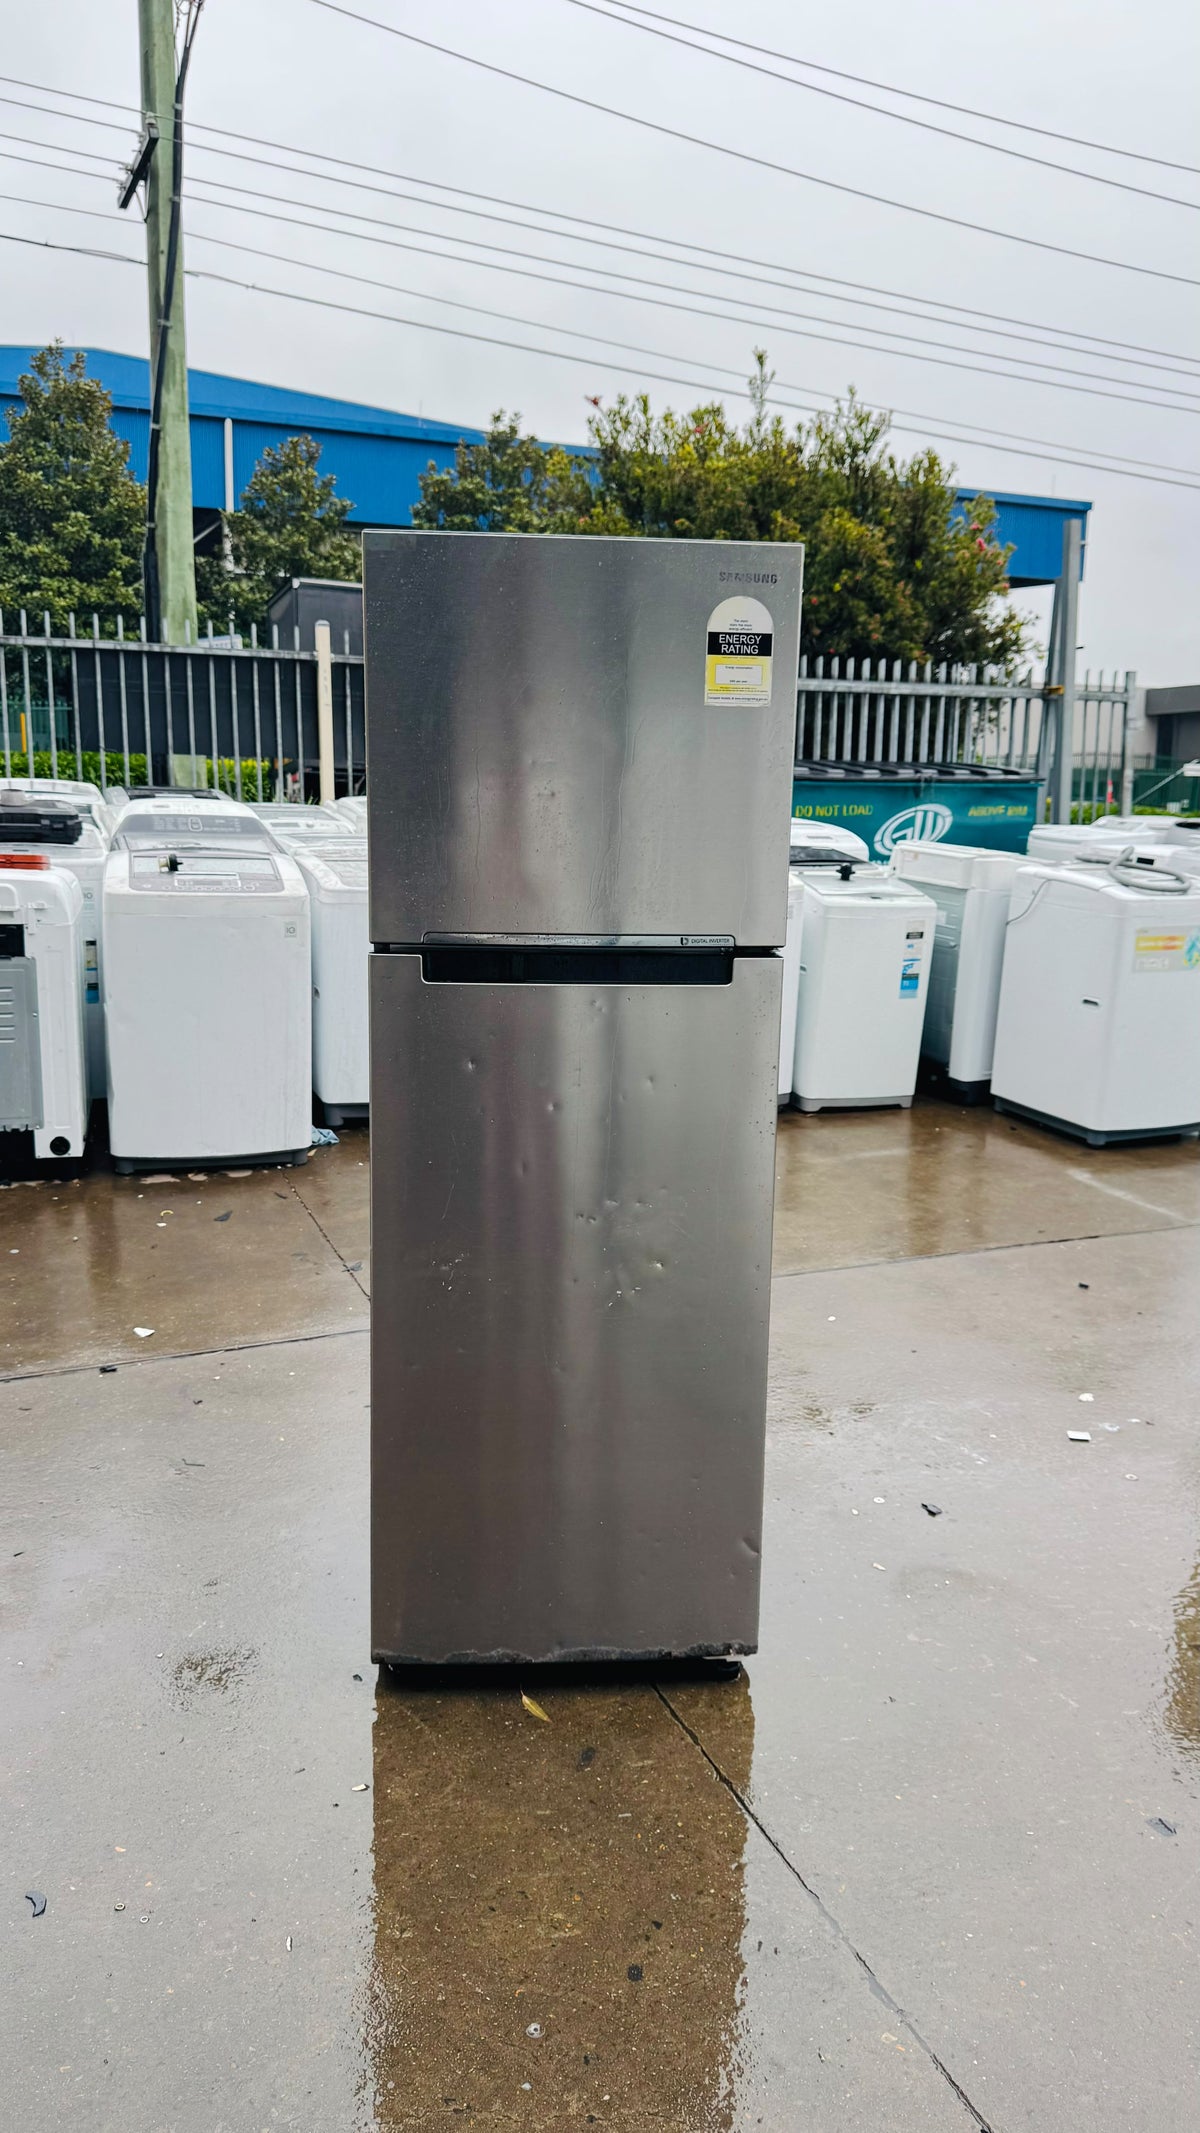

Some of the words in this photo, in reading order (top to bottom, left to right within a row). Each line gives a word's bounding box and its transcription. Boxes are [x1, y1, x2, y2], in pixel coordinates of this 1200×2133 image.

[719, 634, 762, 644] ENERGY
[721, 645, 759, 654] RATING
[795, 805, 813, 817] DO
[815, 804, 839, 817] NOT
[843, 804, 874, 816] LOAD
